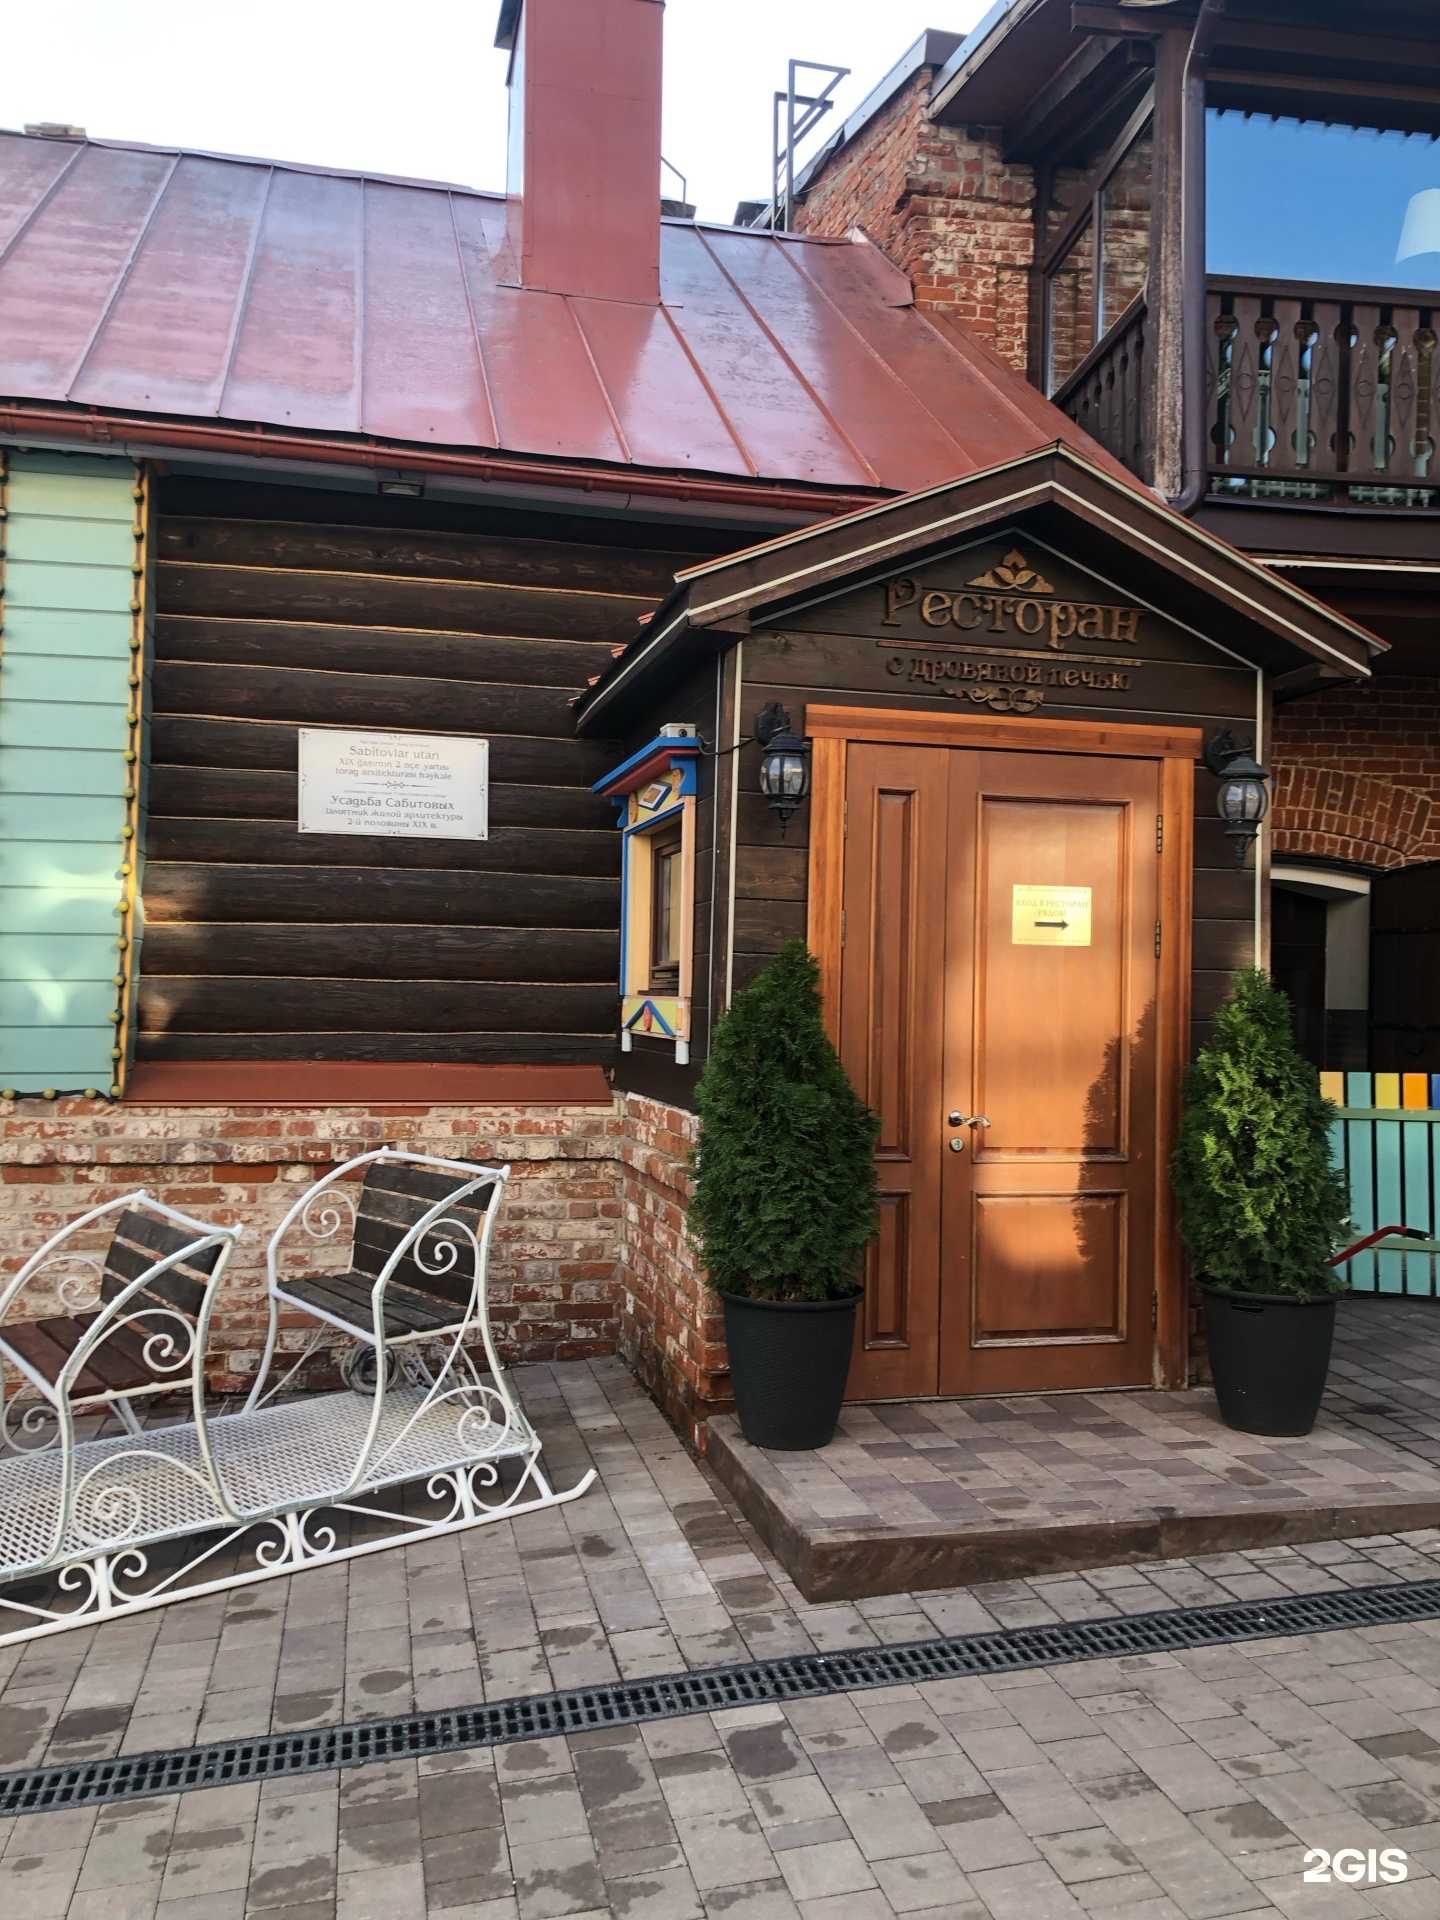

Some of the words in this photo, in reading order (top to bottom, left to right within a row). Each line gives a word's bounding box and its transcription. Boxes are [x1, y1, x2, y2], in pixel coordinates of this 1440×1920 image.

[883, 578, 1144, 650] Ресторан
[909, 657, 1042, 685] дровяной
[1047, 666, 1131, 690] печью
[349, 745, 409, 760] Sabitovlar
[330, 795, 382, 808] Усадьба
[386, 797, 455, 810] Сабитовых
